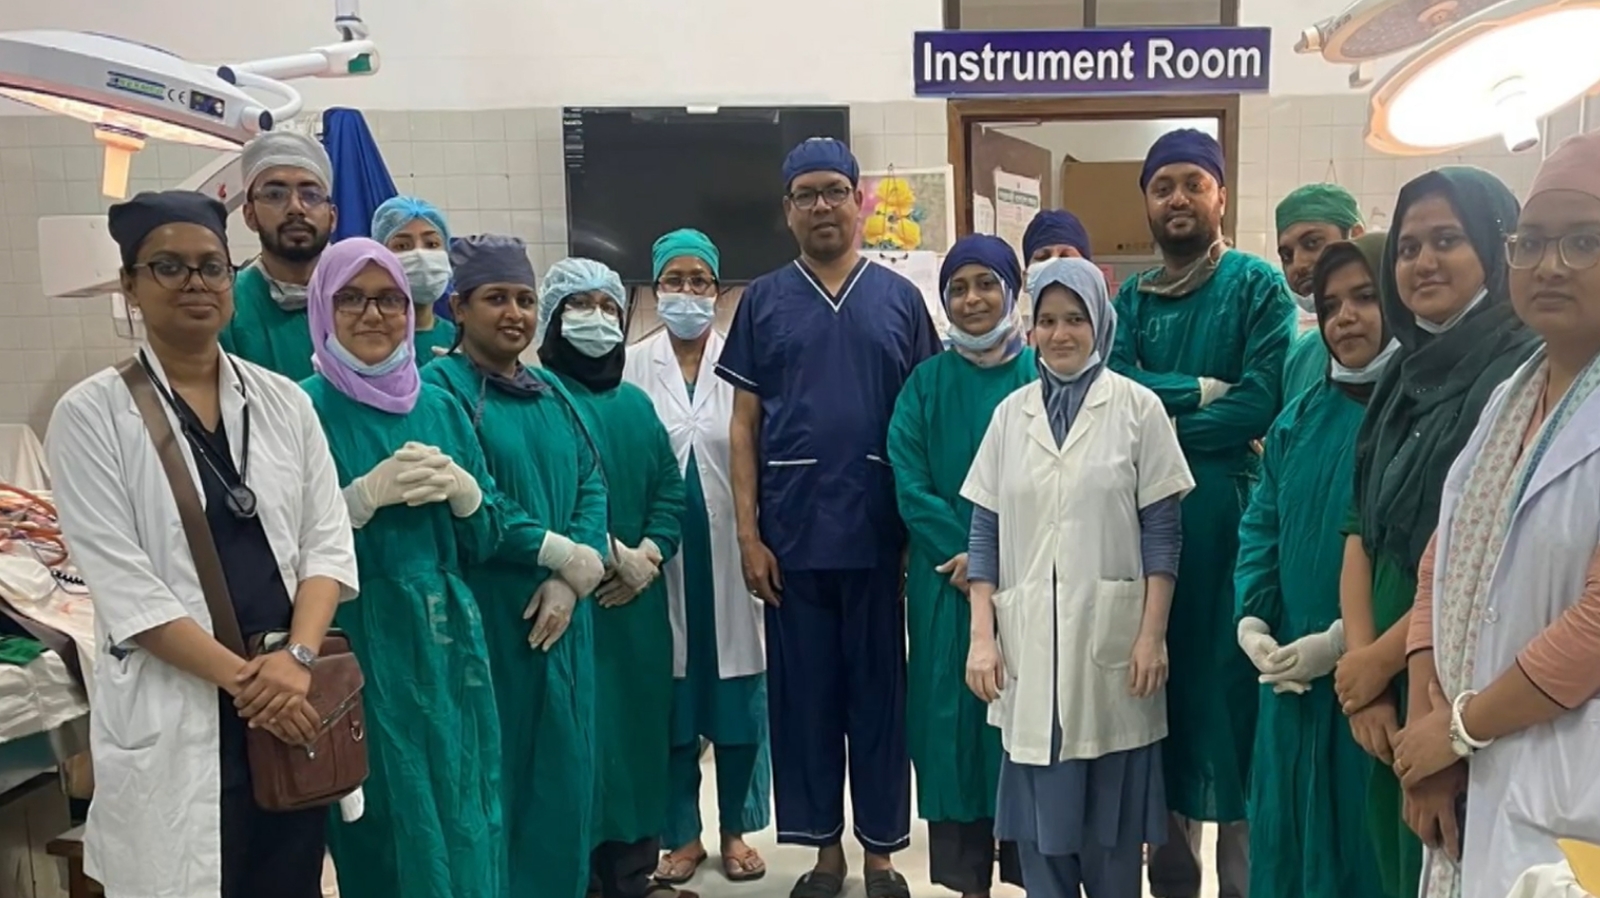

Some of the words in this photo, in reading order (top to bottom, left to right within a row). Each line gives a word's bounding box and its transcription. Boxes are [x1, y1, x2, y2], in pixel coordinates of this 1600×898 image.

[924, 40, 1135, 81] Instrument
[1148, 39, 1261, 79] Room
[167, 88, 186, 105] CE
